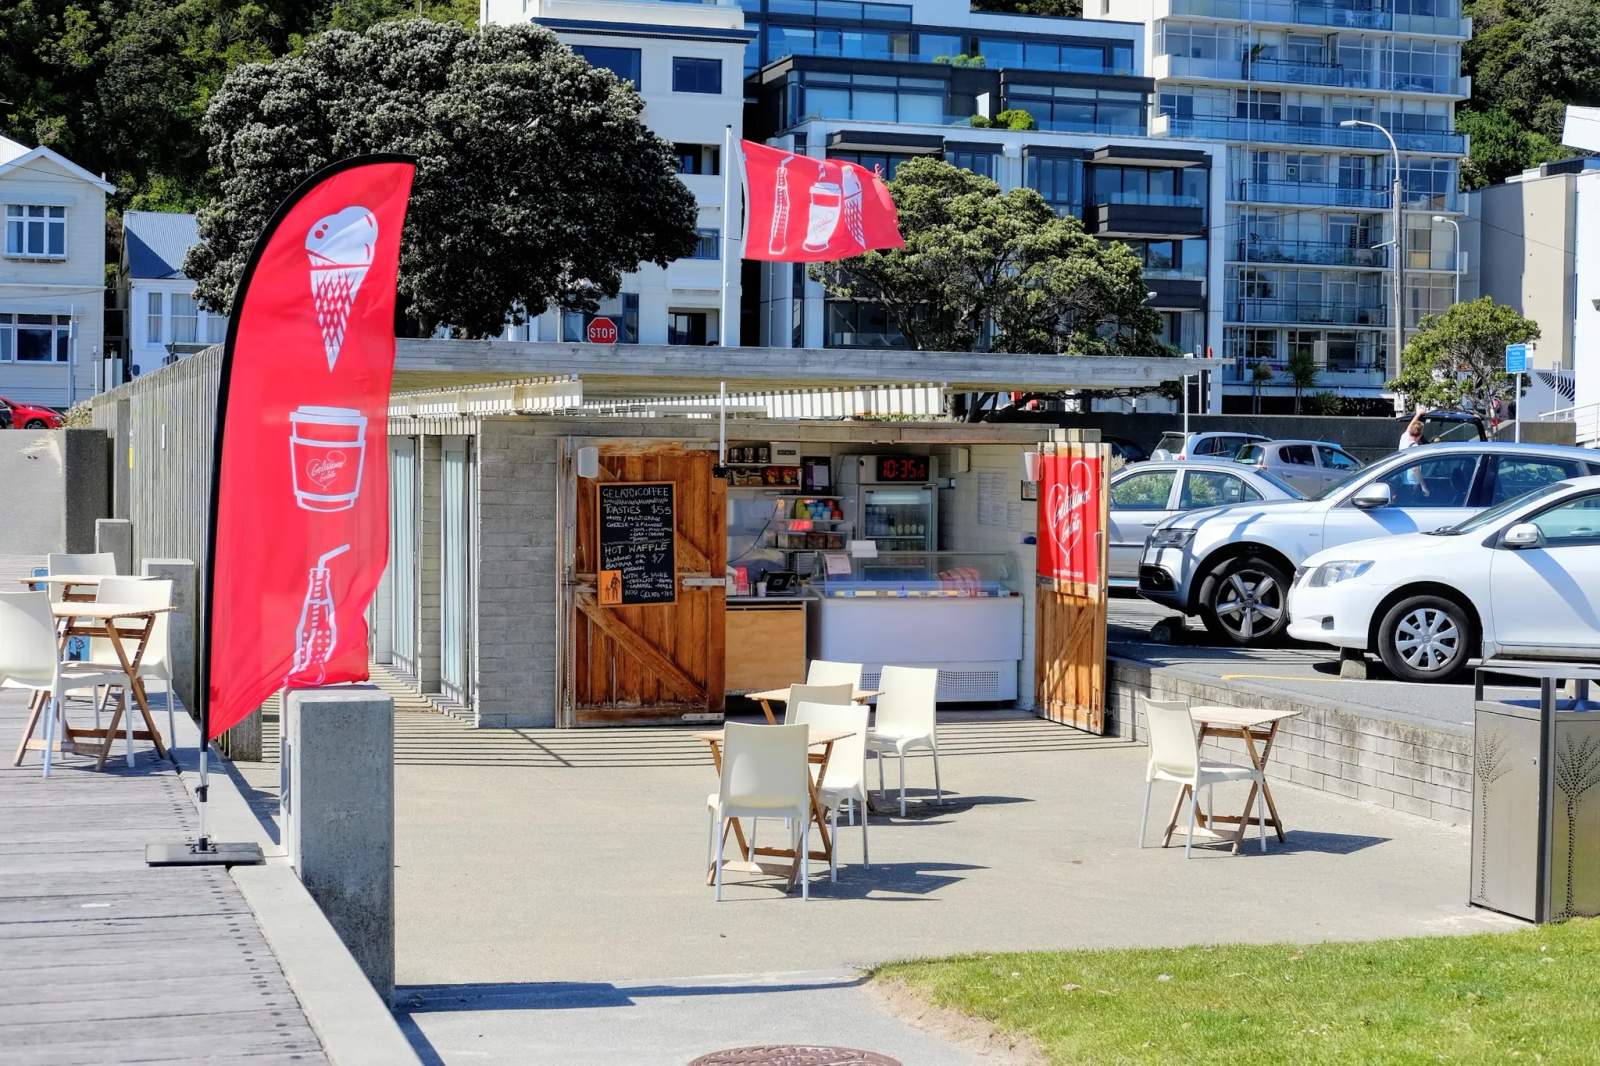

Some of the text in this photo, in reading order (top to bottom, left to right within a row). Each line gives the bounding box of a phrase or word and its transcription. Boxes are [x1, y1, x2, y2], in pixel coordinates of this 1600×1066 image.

[590, 328, 615, 338] STOP
[883, 460, 917, 478] 10:35
[603, 488, 635, 498] GELATO
[603, 503, 641, 515] TOASTIES
[604, 543, 667, 556] HOT WAFFLE
[652, 553, 665, 563] $7
